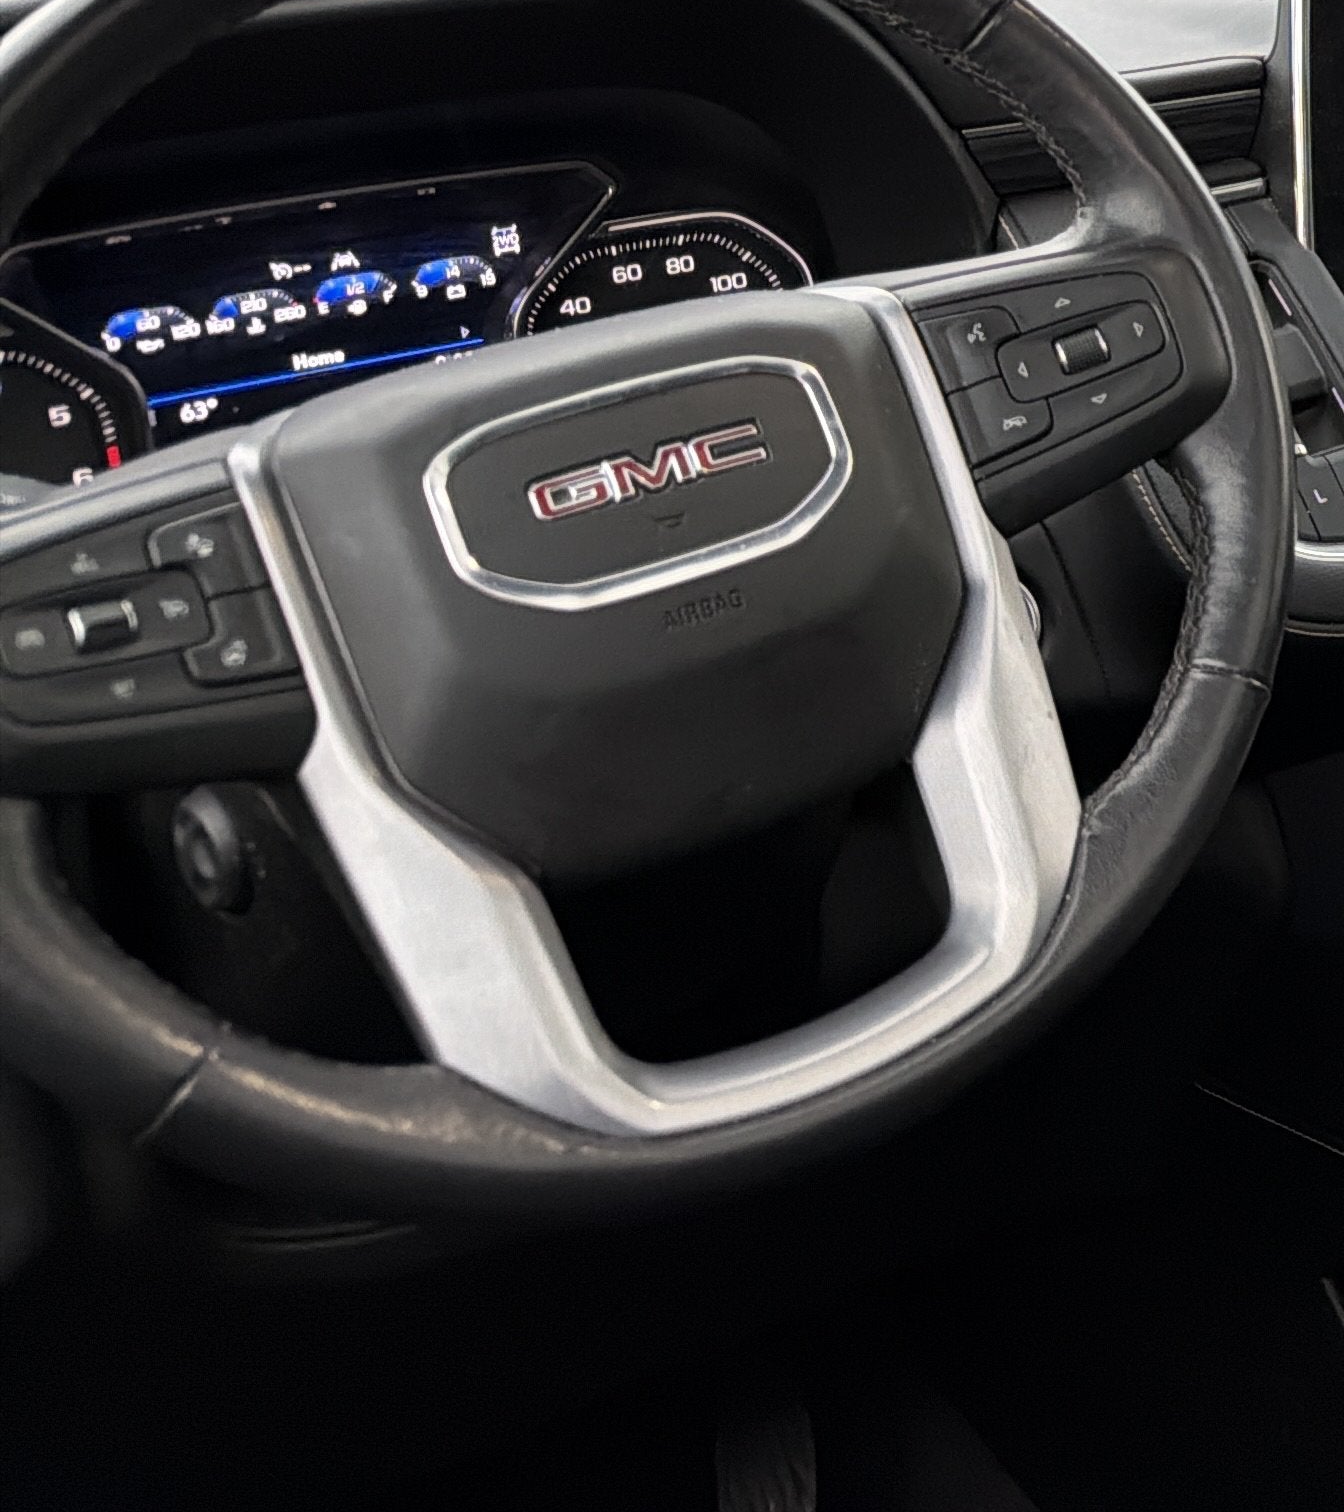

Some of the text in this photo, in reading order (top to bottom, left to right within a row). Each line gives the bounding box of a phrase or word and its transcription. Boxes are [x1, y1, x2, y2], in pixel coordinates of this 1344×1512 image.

[445, 264, 461, 279] 14
[611, 263, 643, 284] 60
[665, 254, 695, 275] 80
[710, 272, 748, 293] 100
[383, 289, 395, 304] F
[560, 296, 592, 317] 40
[318, 302, 330, 315] E
[171, 323, 201, 340] 120
[205, 318, 235, 335] 160
[292, 348, 346, 371] Home
[48, 404, 72, 428] 5
[180, 397, 219, 424] 63°
[527, 422, 768, 522] GMC
[660, 588, 747, 631] AIRBAG
